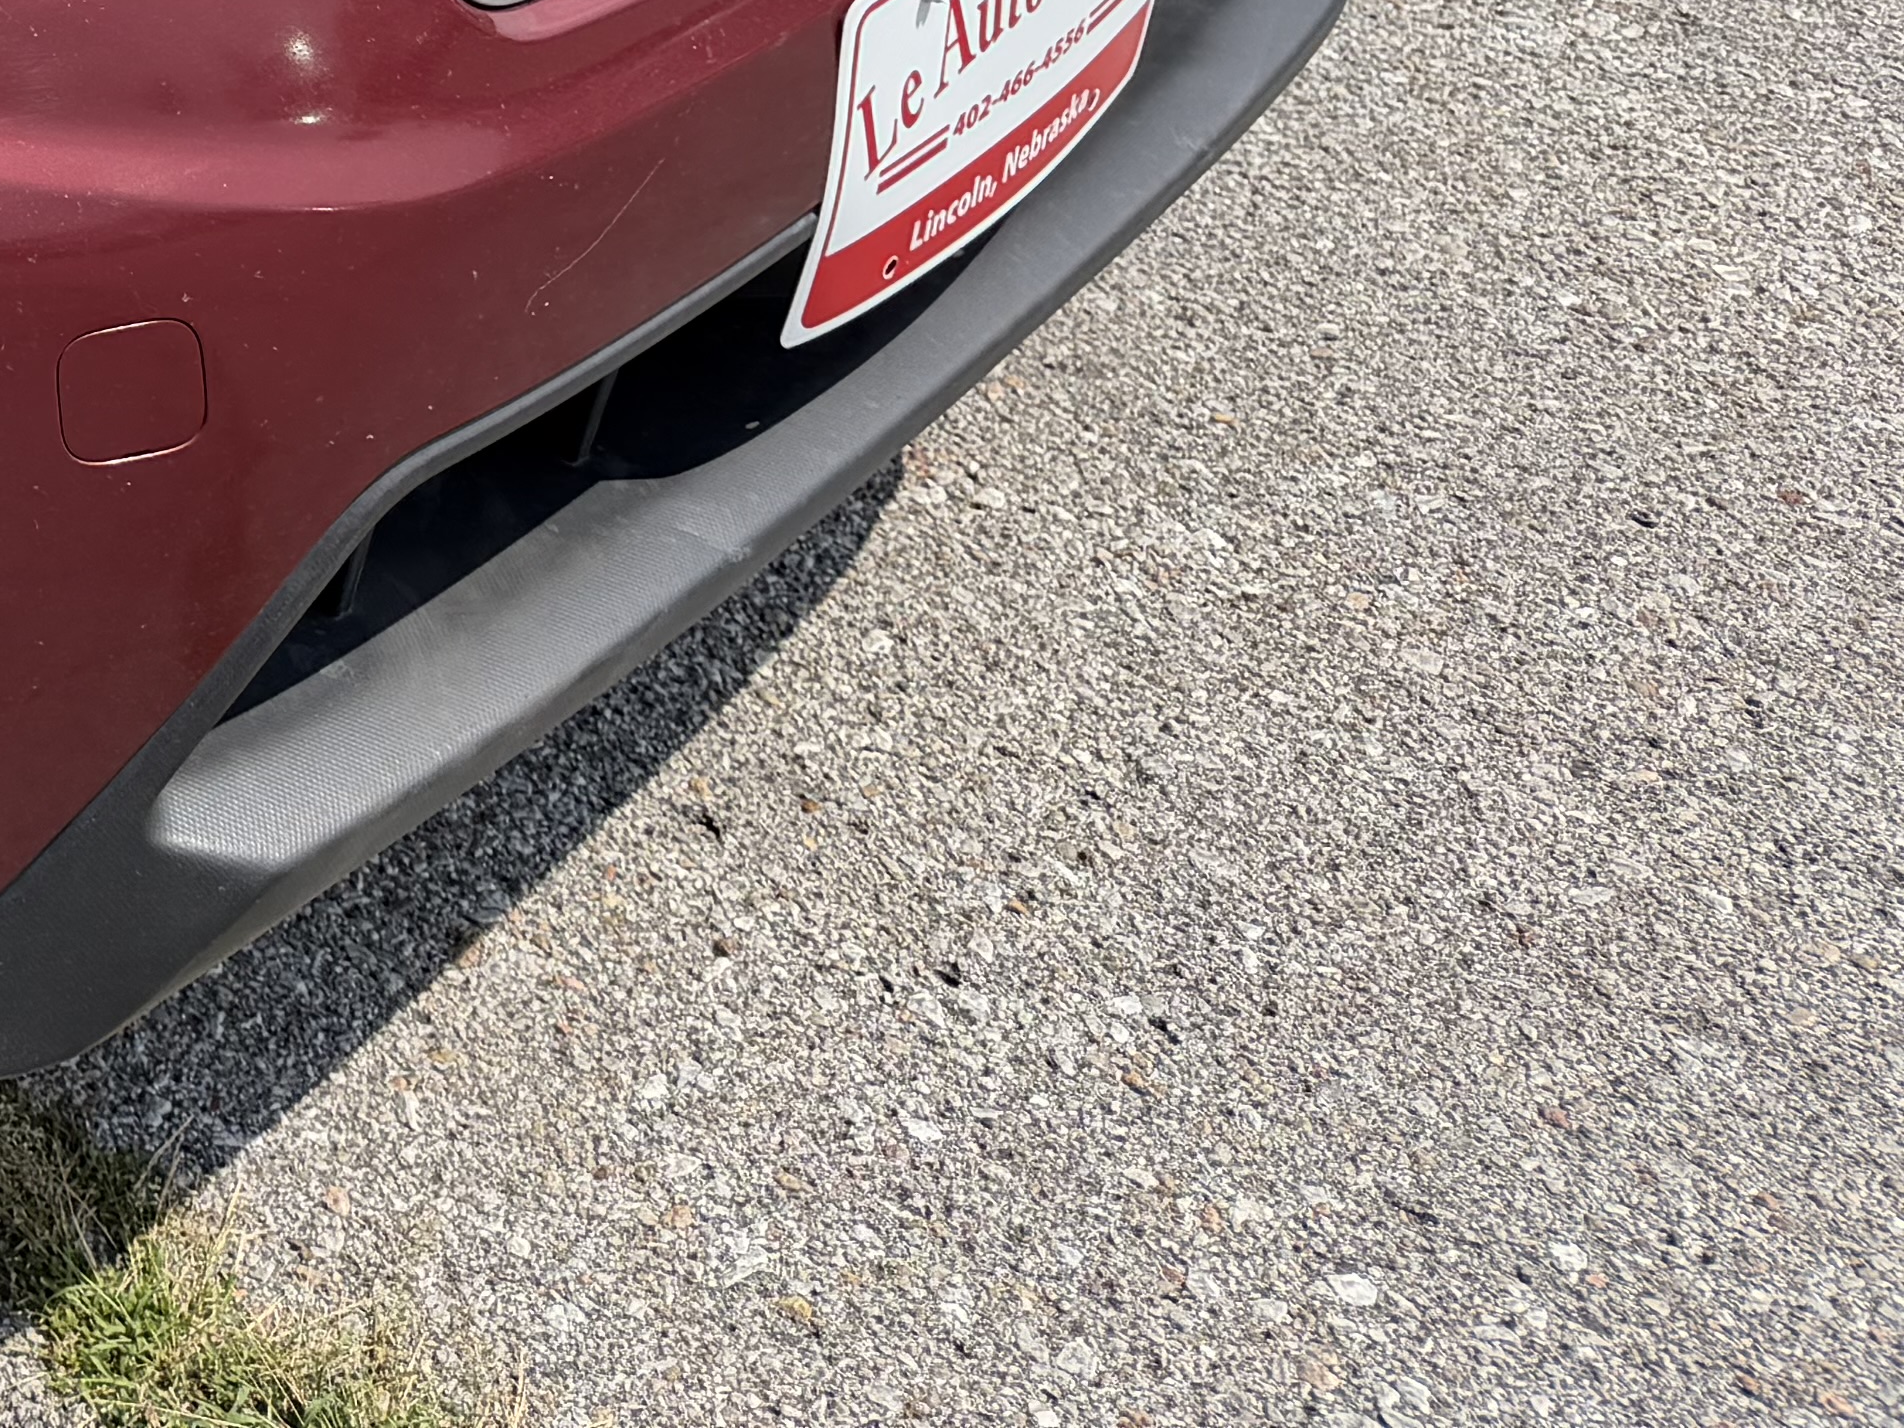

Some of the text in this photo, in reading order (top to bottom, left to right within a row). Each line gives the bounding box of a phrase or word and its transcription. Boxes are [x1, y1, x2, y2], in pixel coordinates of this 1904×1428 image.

[857, 70, 925, 182] Le
[953, 18, 1086, 136] 402-466-4556
[909, 88, 1090, 252] Lincoln, Nebraska
